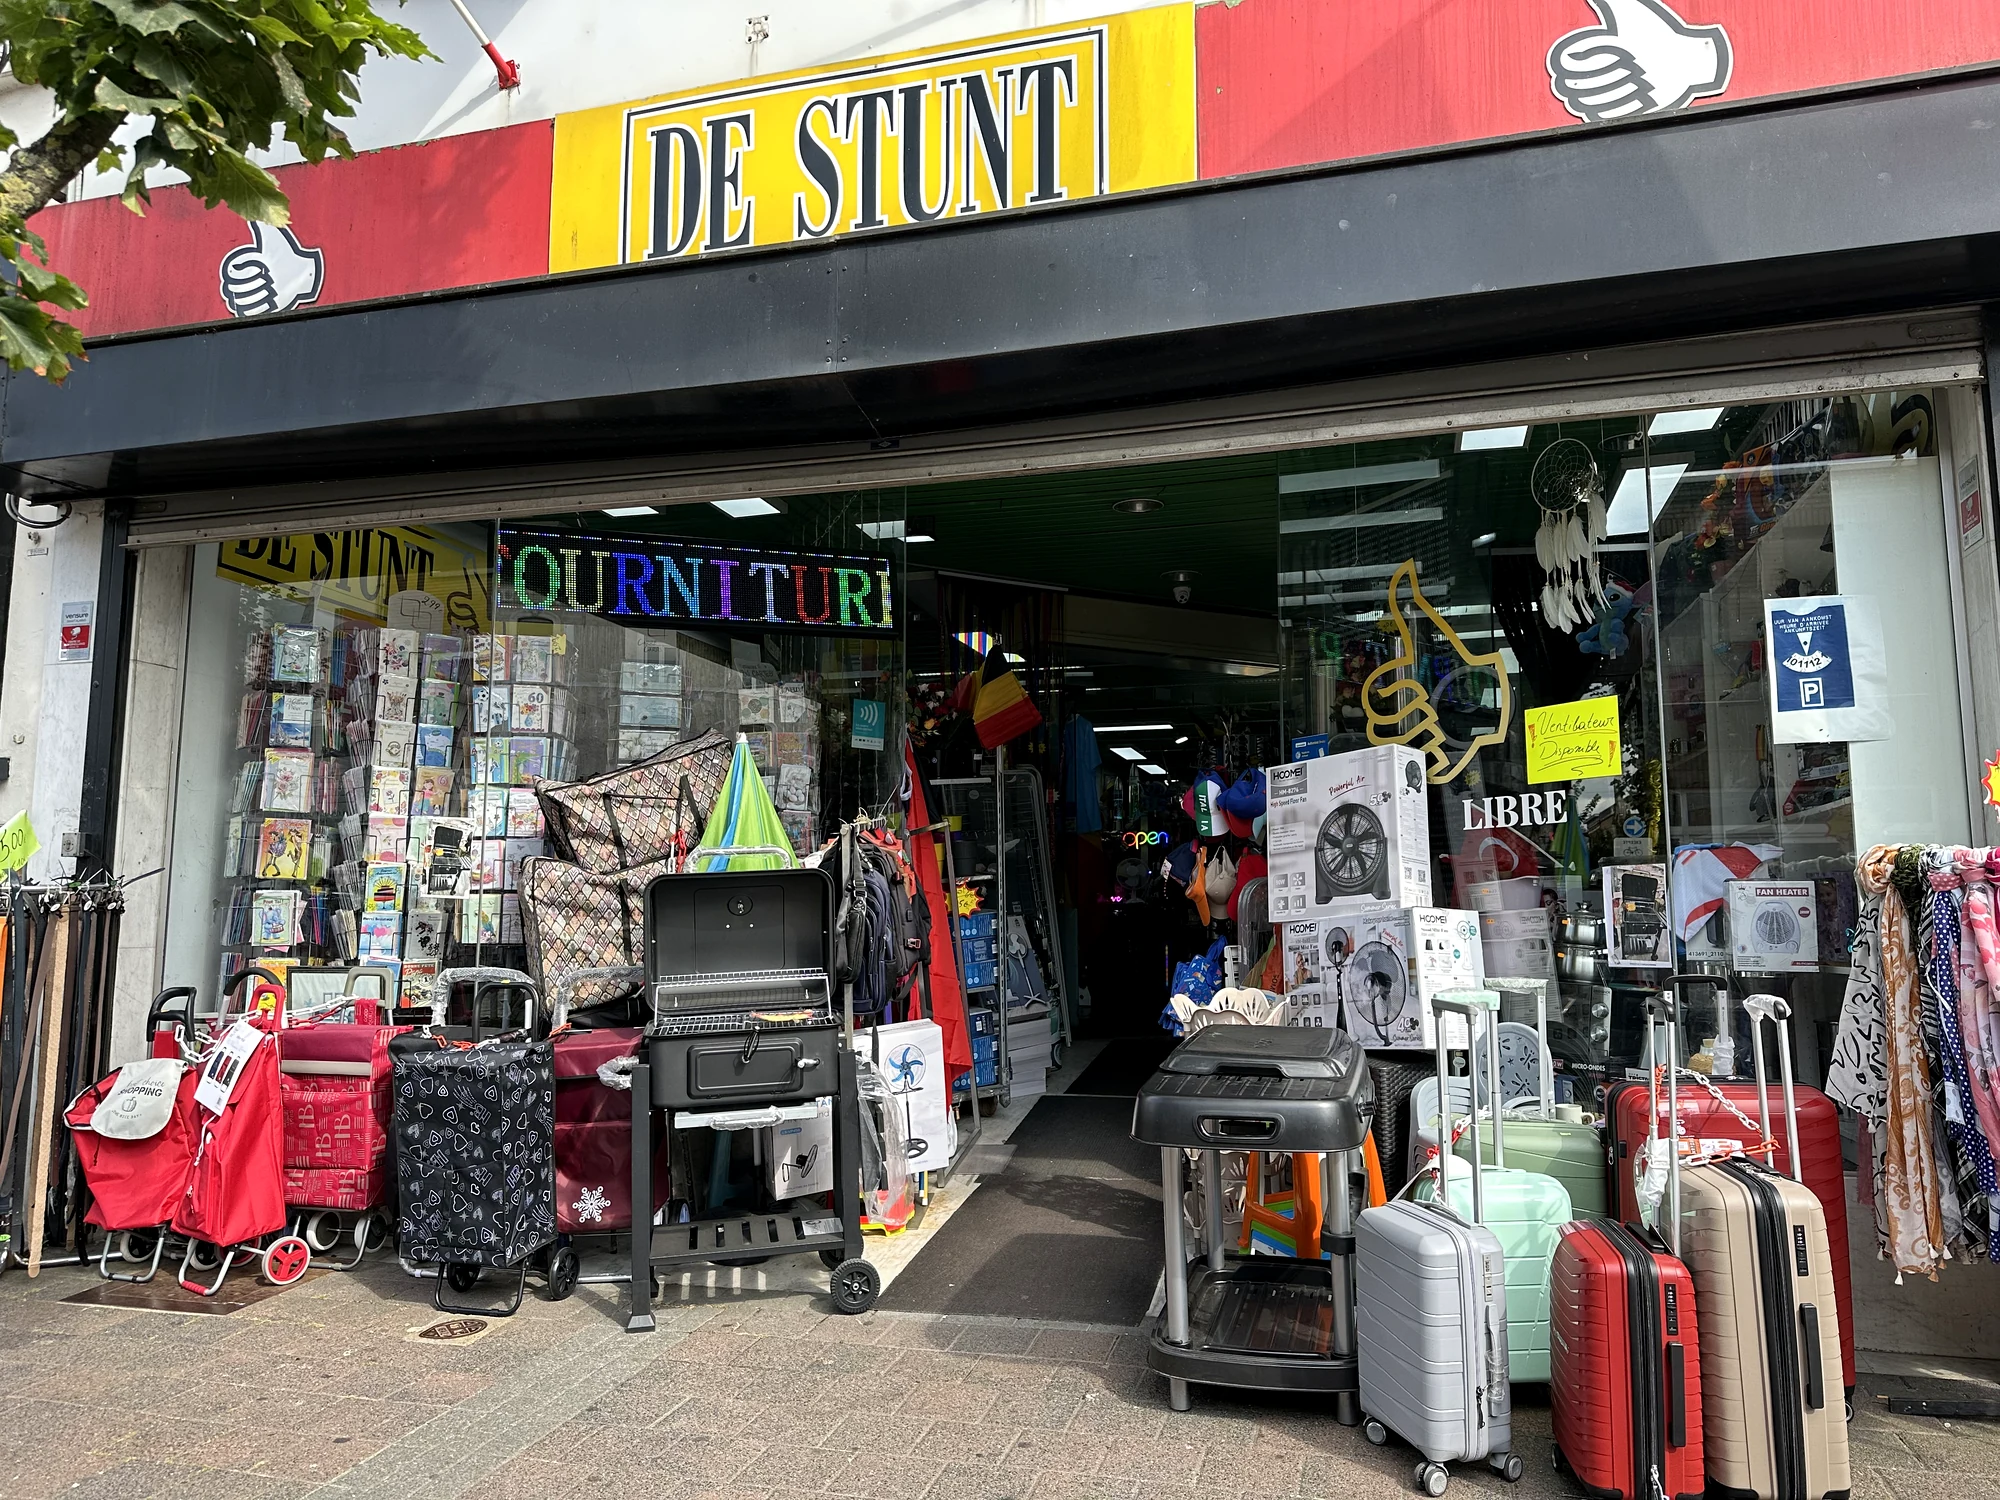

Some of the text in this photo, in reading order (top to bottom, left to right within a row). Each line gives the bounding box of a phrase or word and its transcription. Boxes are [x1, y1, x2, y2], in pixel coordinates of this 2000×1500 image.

[645, 55, 1077, 261] DE STUNT
[499, 543, 893, 628] OURNITUR
[65, 612, 89, 620] verisure
[1801, 614, 1832, 622] AANKOMST
[1784, 625, 1825, 633] ANKUNFTSZEIT
[528, 692, 543, 704] 60
[1804, 682, 1819, 703] P
[1273, 767, 1303, 780] HOOMEI
[1328, 775, 1365, 796] Powerful Air
[1270, 801, 1278, 809] High
[1279, 799, 1290, 808] Speed
[1462, 790, 1568, 831] LIBRE
[1122, 831, 1169, 849] open
[1756, 888, 1808, 896] FAN HEATER
[1360, 904, 1380, 913] Summer
[1419, 914, 1448, 924] HOOMEI
[1290, 923, 1316, 934] HOOMEI
[1571, 1062, 1606, 1072] MICRO-ONDES
[118, 1086, 163, 1097] SHOPPING
